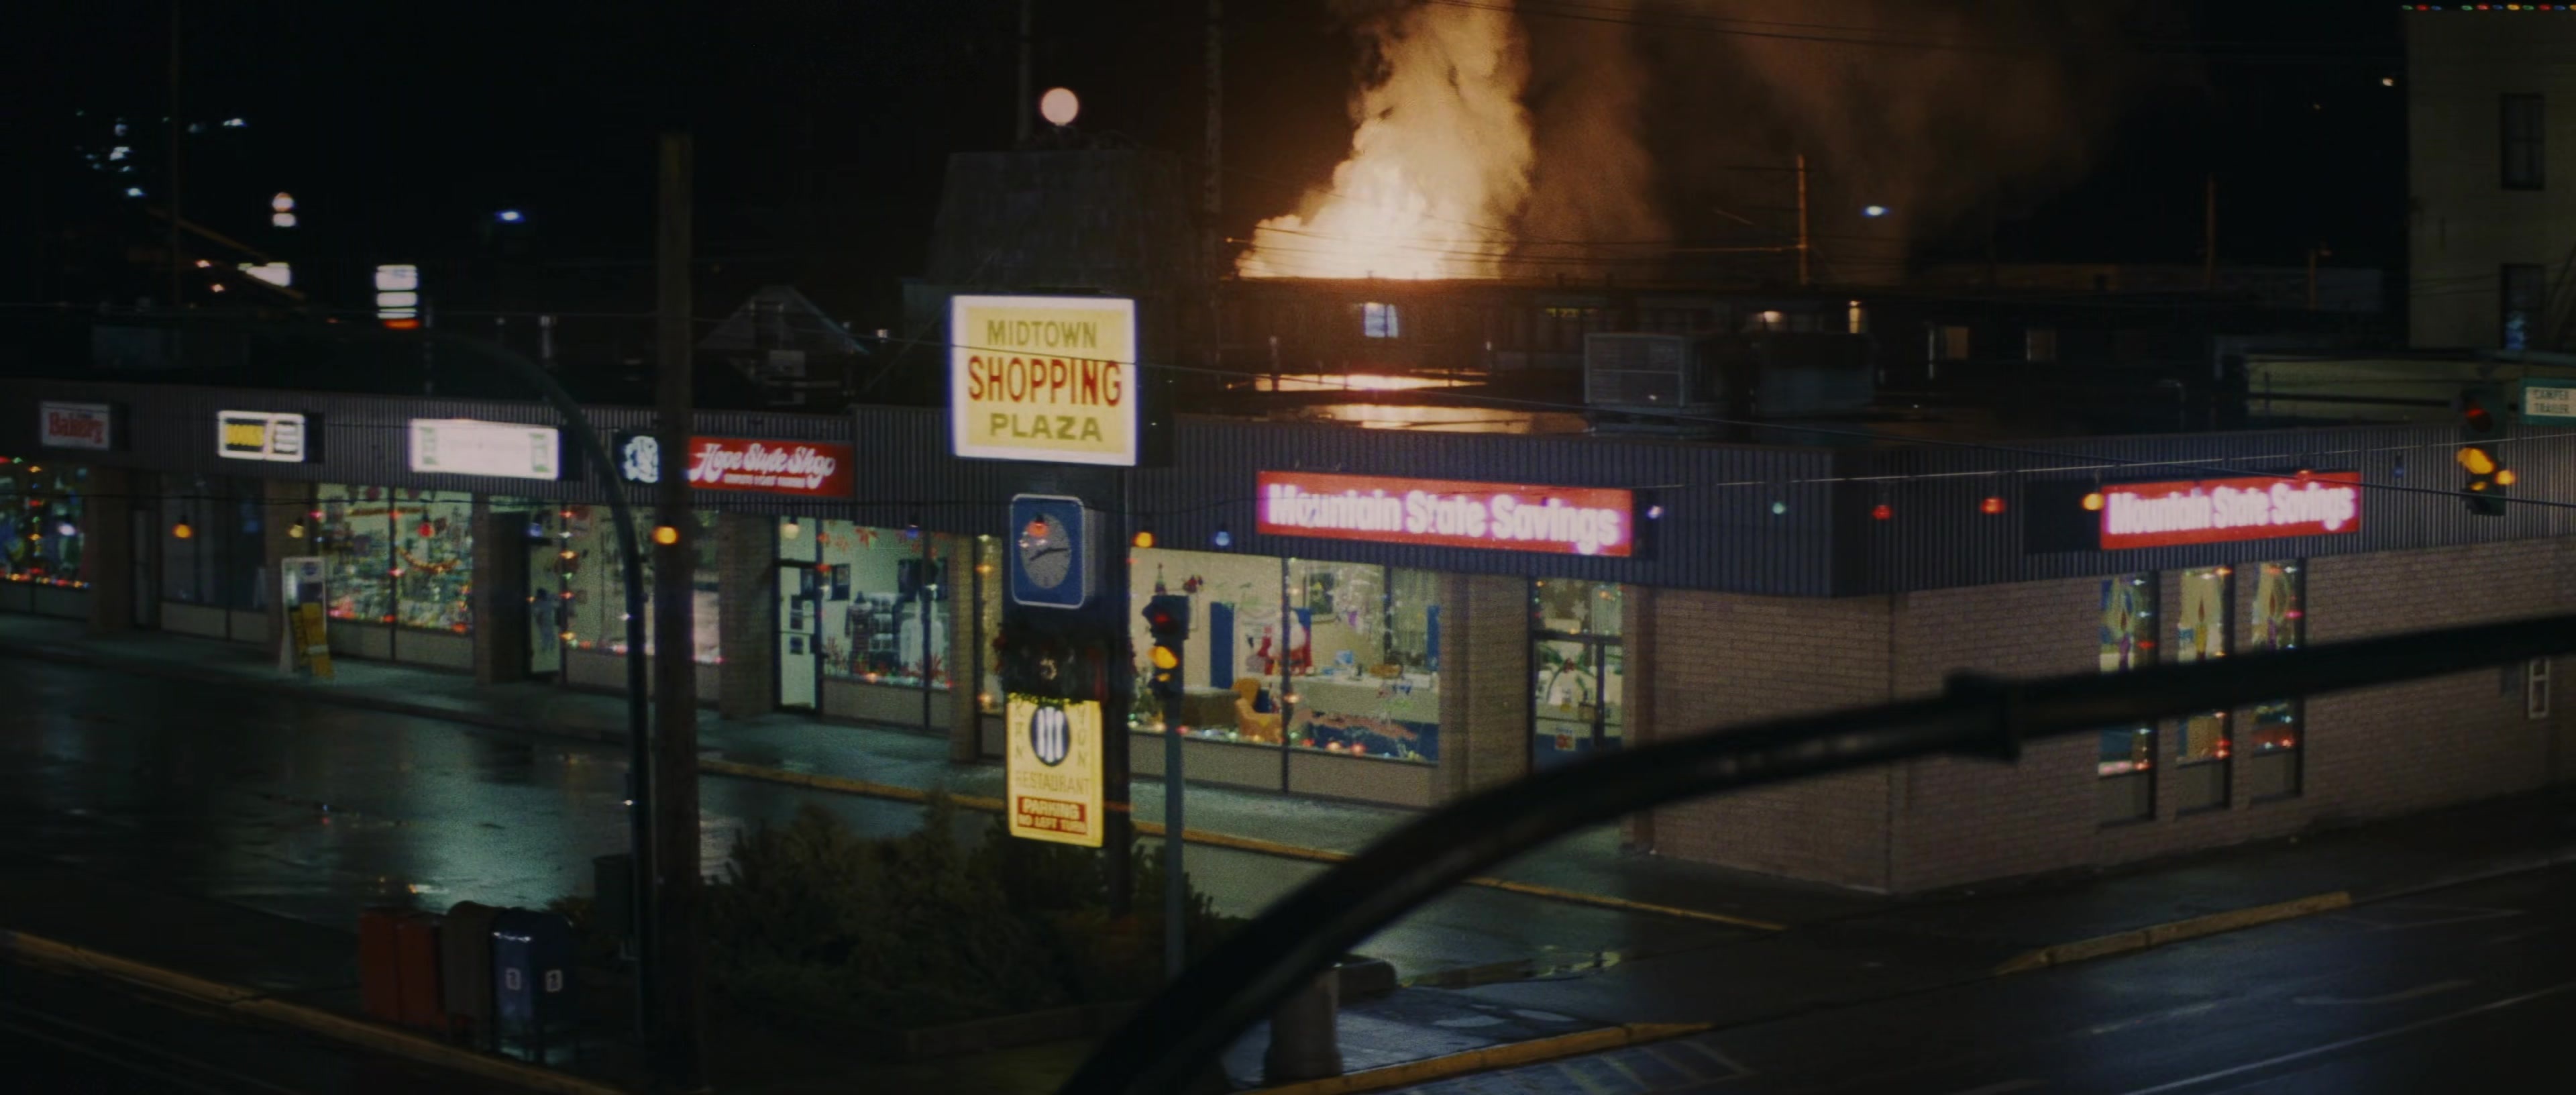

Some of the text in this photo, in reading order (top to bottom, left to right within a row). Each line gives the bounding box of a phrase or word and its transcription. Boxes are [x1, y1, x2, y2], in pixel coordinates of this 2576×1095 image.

[987, 319, 1097, 348] MIDTOWN
[967, 355, 1122, 407] SHOPPING
[989, 412, 1103, 442] PLAZA
[788, 446, 837, 490] Shop
[1267, 483, 1619, 555] Mountain State Savings
[2108, 482, 2355, 535] Mountain State Savings
[1015, 771, 1090, 795] RESTAURANT
[1022, 798, 1080, 820] PARKING
[1034, 816, 1058, 829] LEFT
